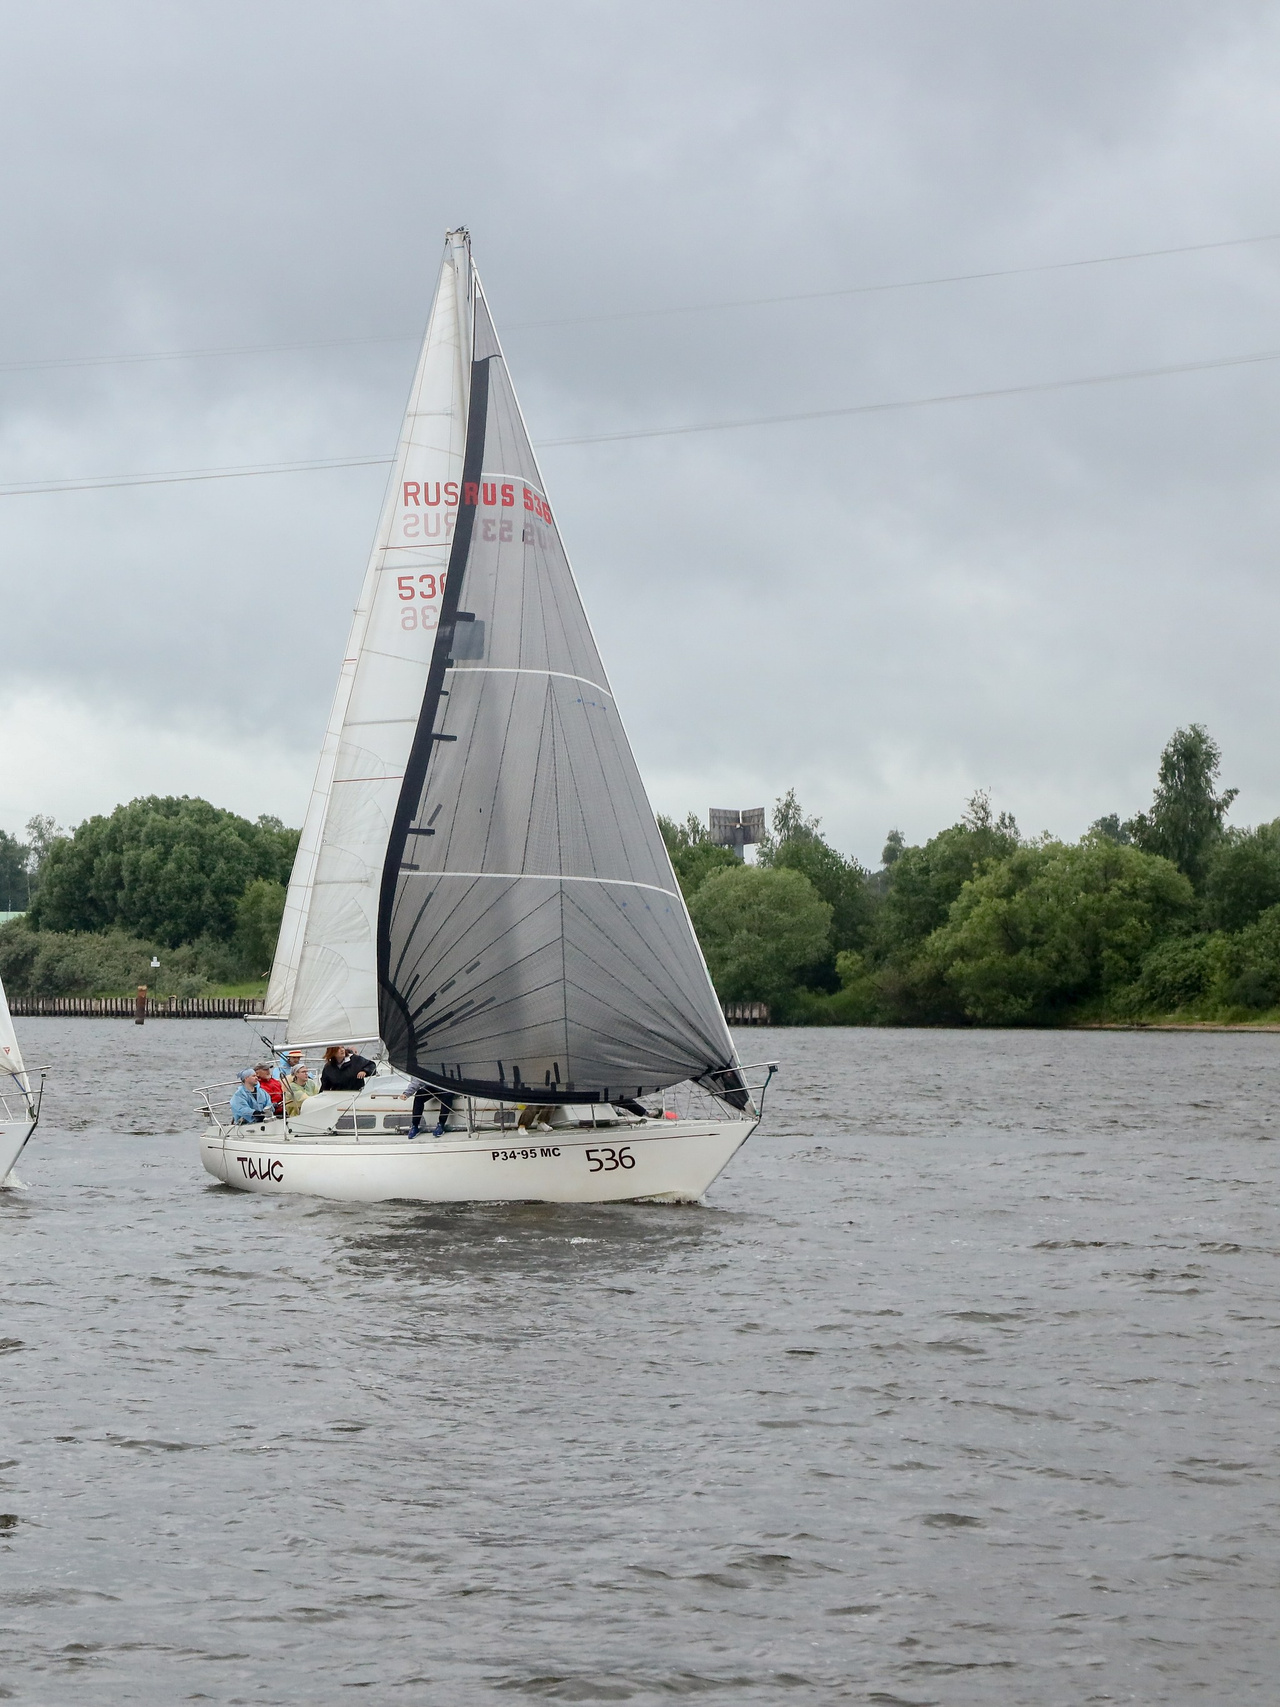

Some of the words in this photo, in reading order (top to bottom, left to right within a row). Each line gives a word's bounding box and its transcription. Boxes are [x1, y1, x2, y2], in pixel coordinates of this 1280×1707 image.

[403, 482, 459, 507] RUS
[464, 482, 515, 507] RUS
[523, 487, 552, 525] 536
[585, 1146, 636, 1173] 536
